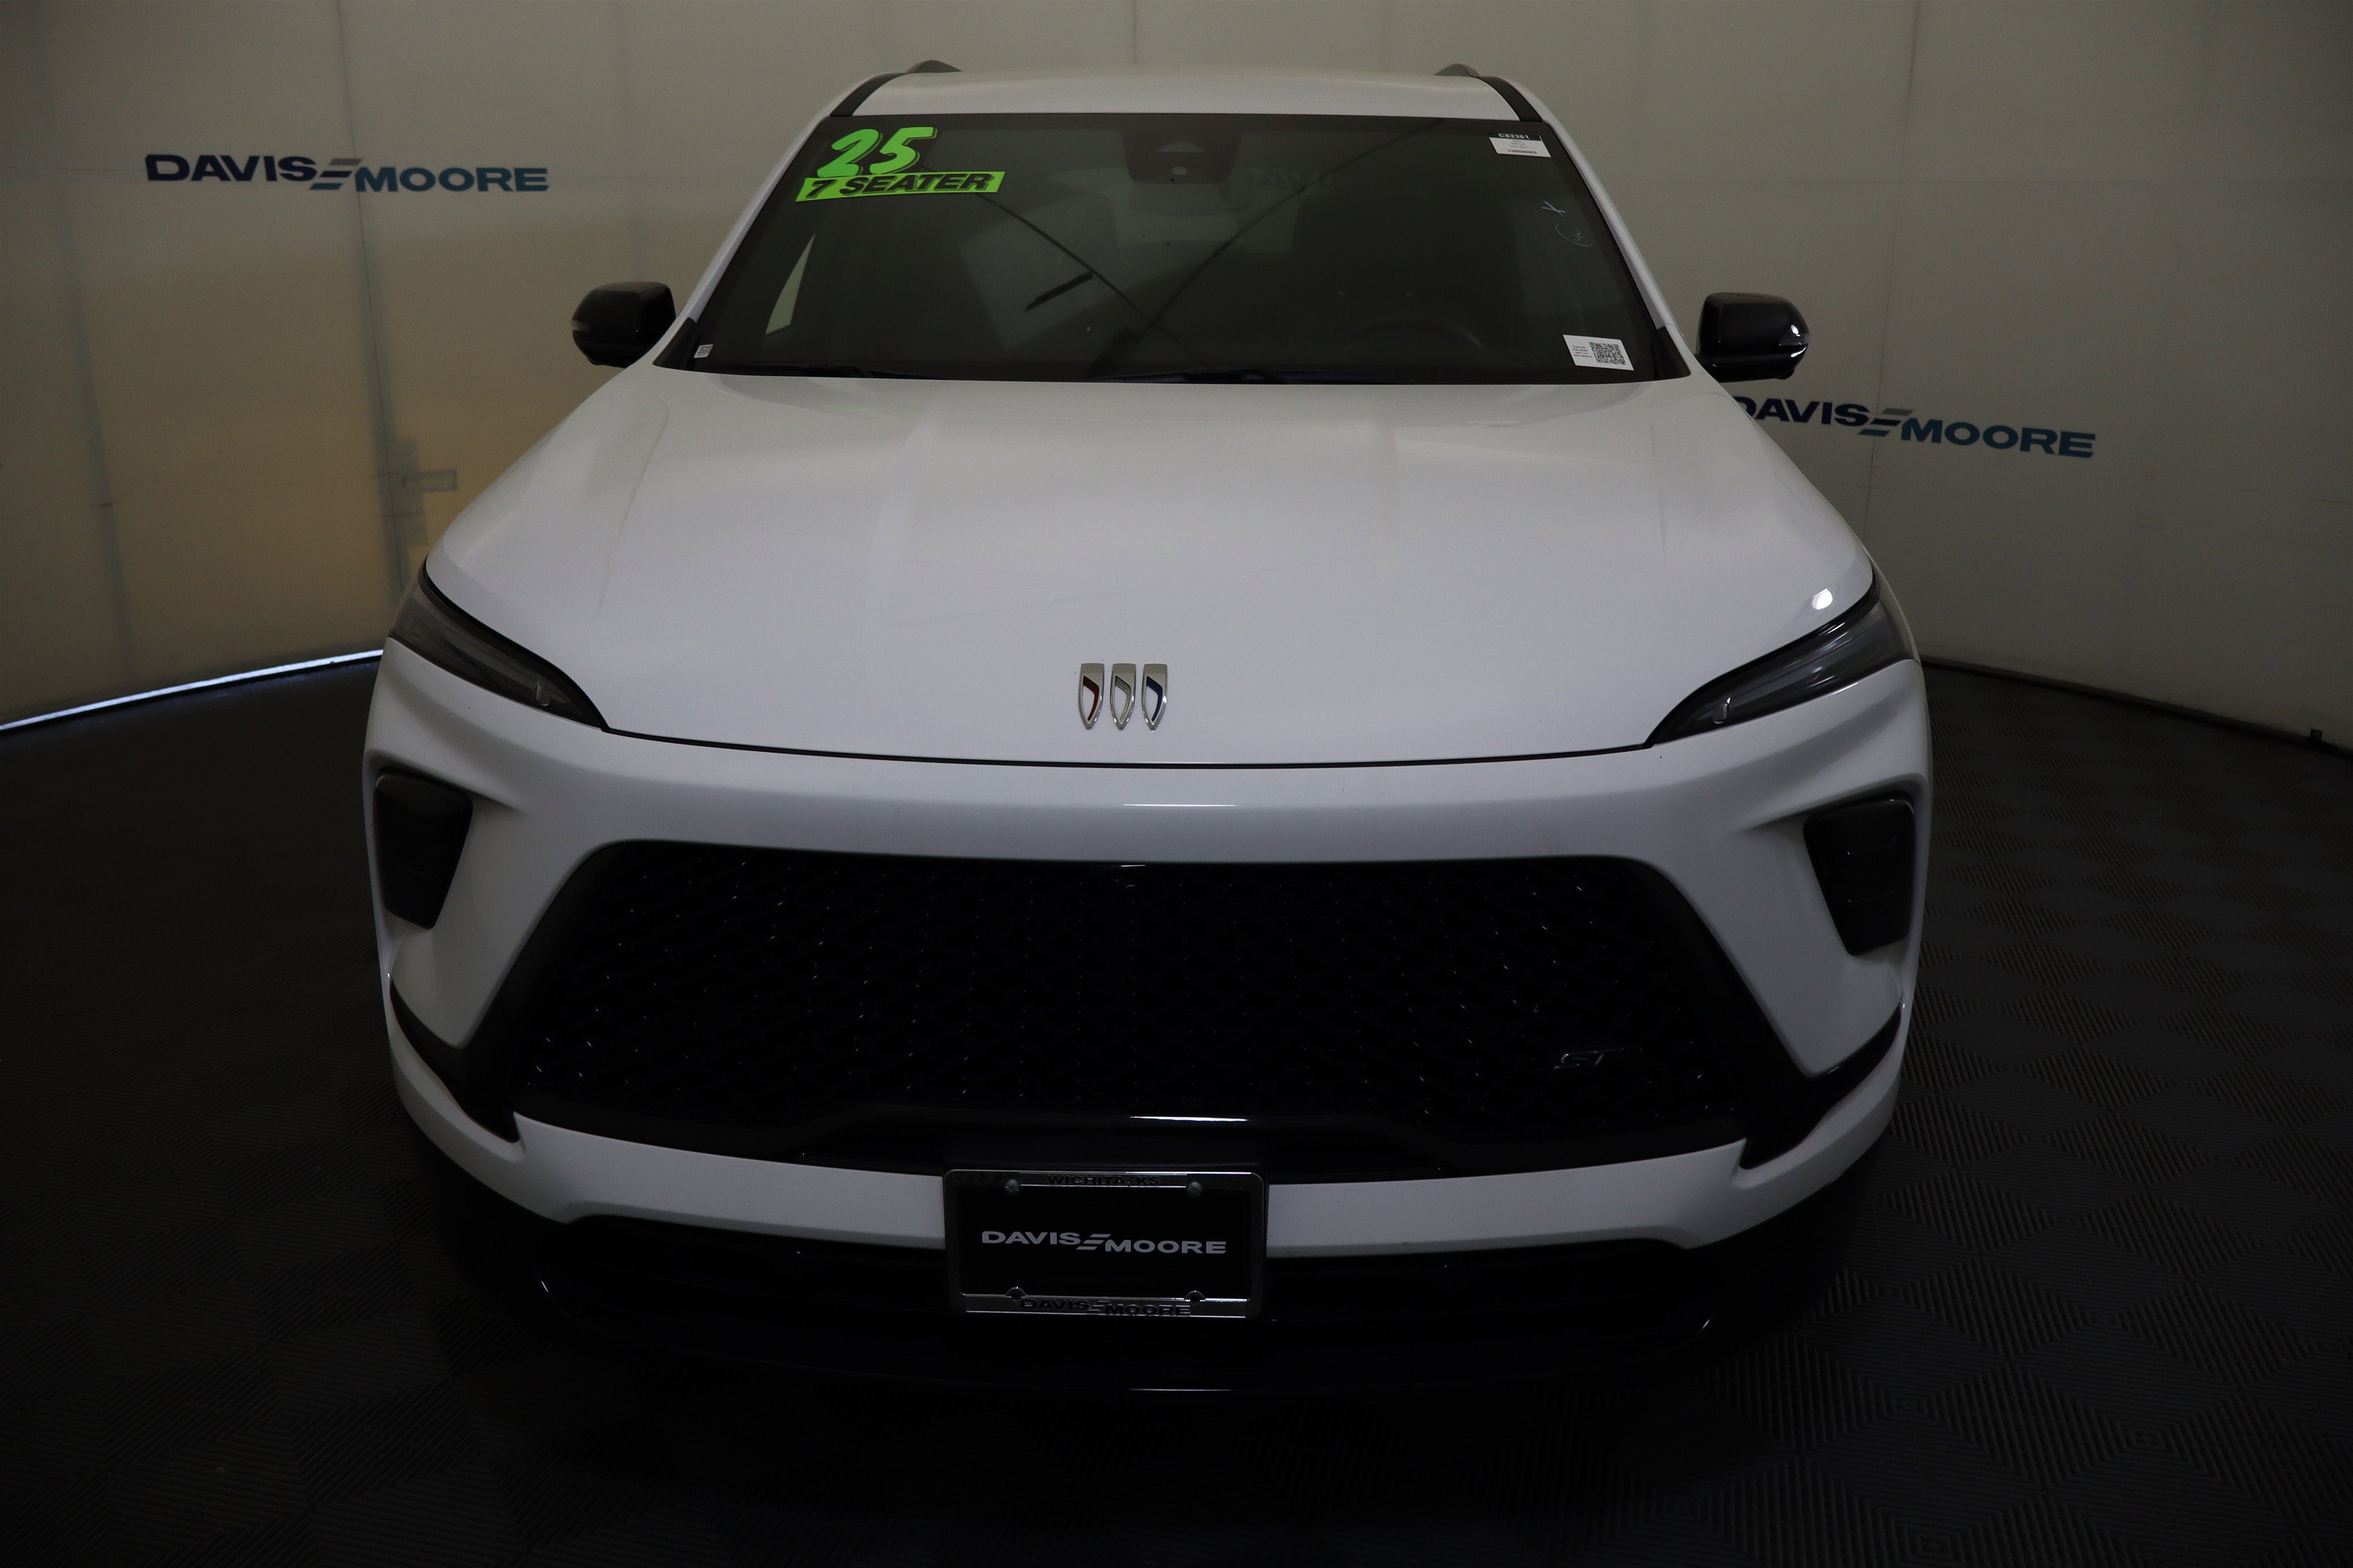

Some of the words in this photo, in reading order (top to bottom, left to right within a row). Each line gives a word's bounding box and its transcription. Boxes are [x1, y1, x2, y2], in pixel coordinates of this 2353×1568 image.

[816, 126, 938, 177] 25
[145, 154, 317, 181] DAVIS
[355, 167, 549, 192] MOORE
[806, 179, 838, 199] 7
[839, 173, 994, 196] SEATER
[1901, 417, 2096, 458] MOORE
[1136, 1176, 1159, 1185] KS
[982, 1230, 1081, 1245] DAVIS
[1105, 1239, 1227, 1254] MOORE
[1020, 1299, 1090, 1310] DAVIS
[1105, 1304, 1191, 1316] MOORE
